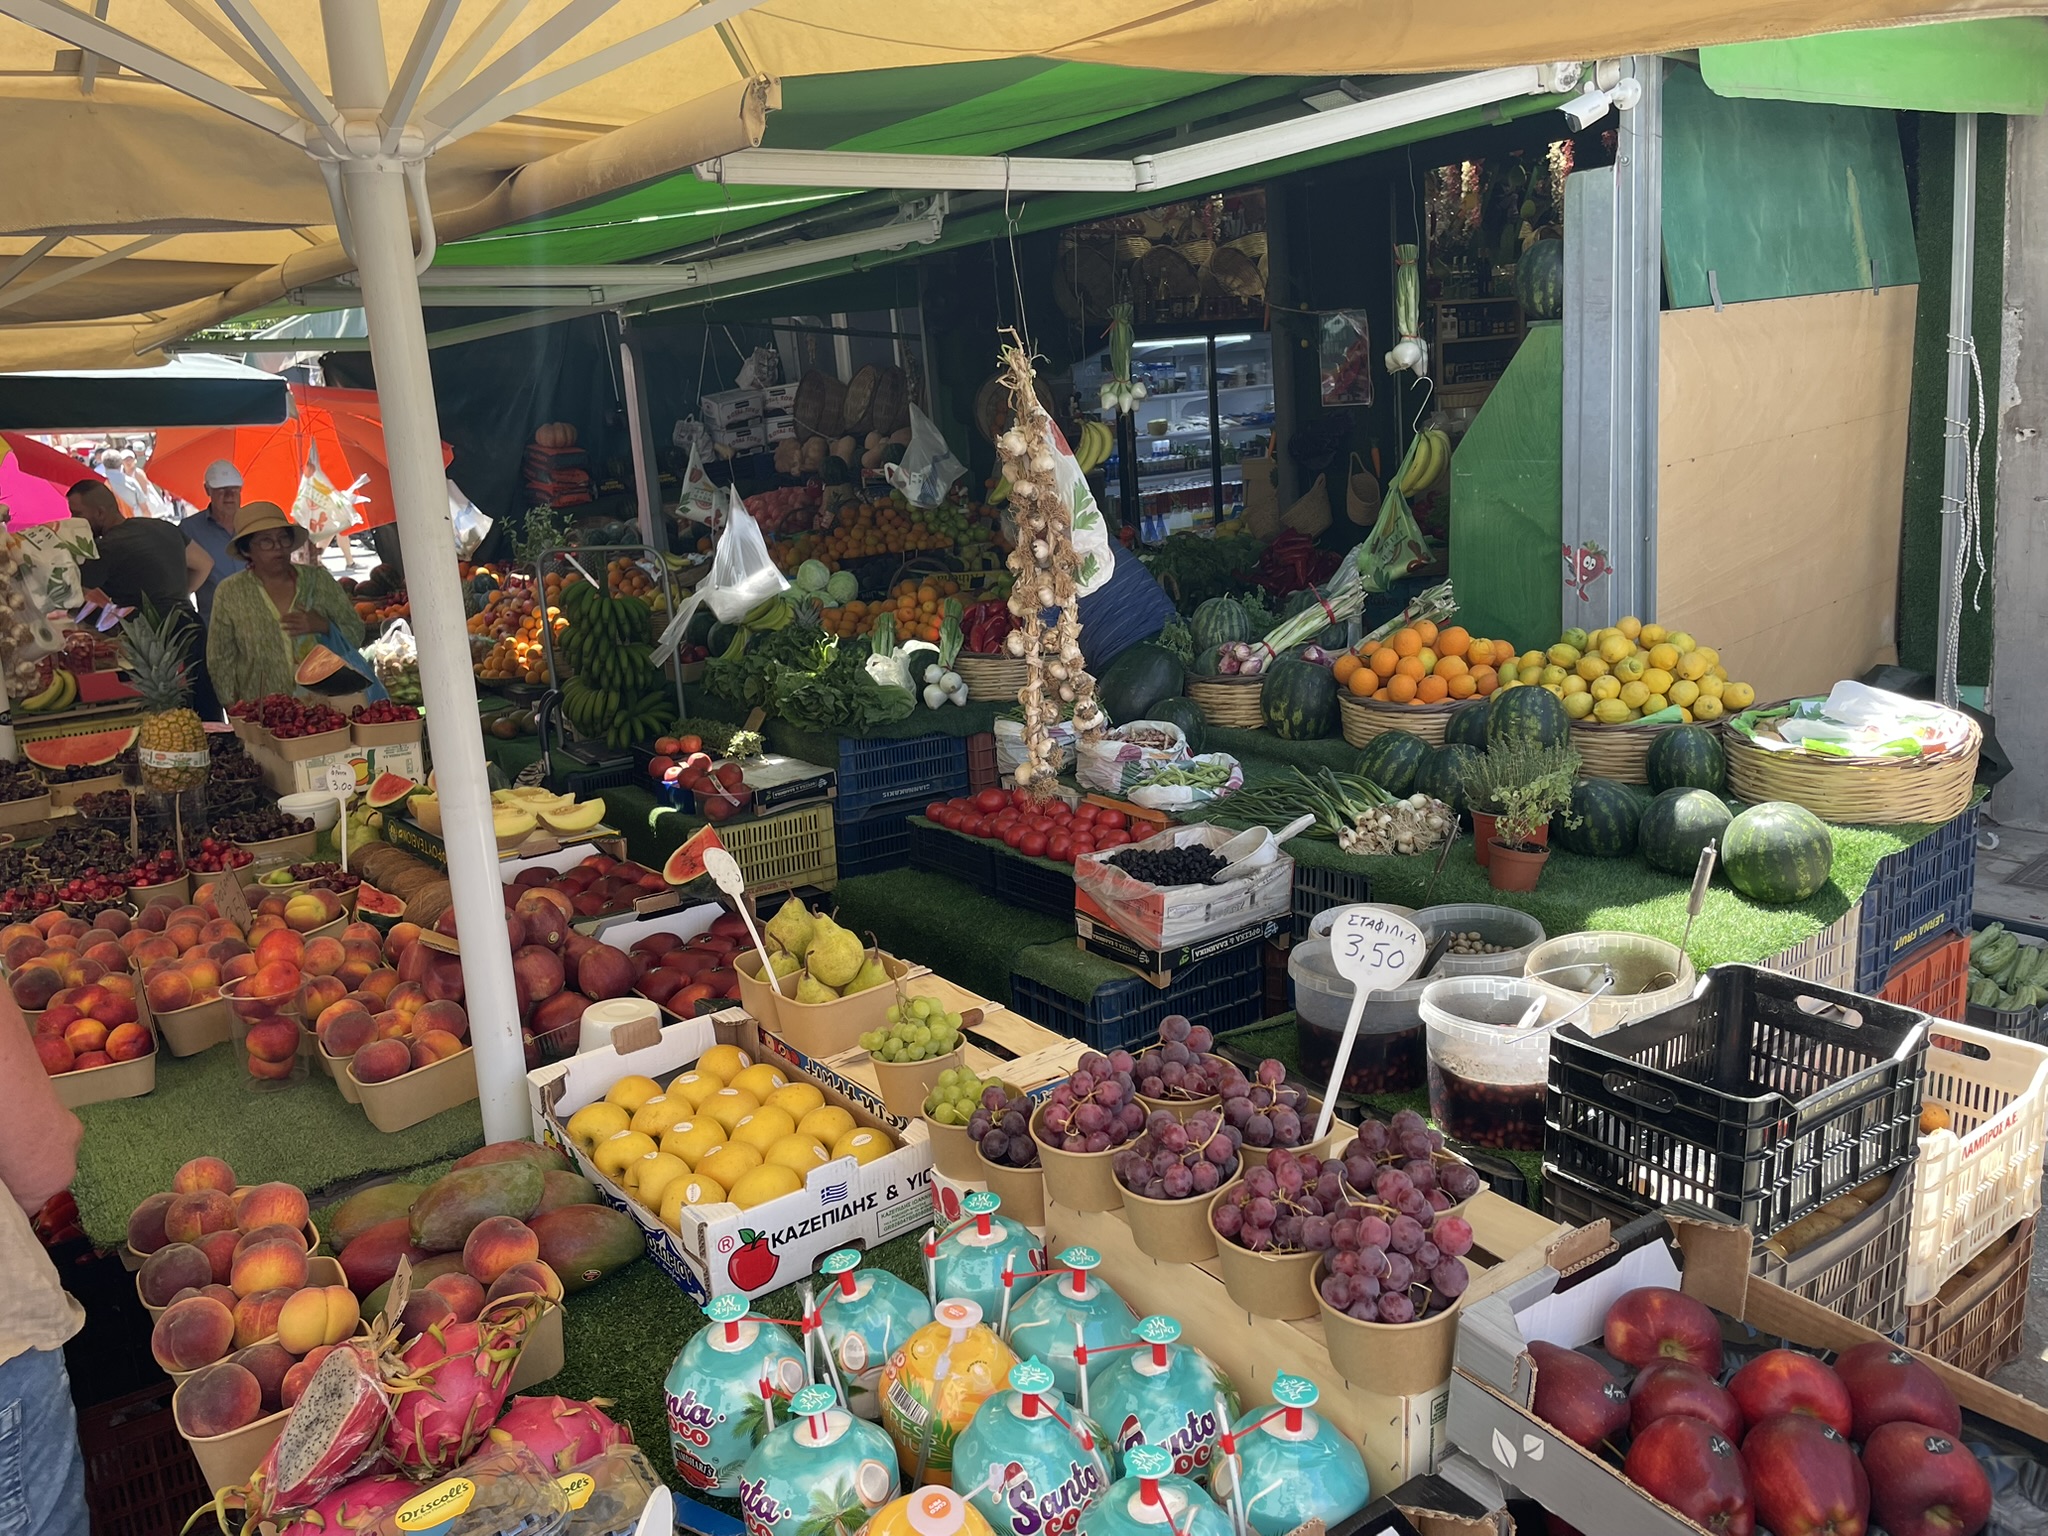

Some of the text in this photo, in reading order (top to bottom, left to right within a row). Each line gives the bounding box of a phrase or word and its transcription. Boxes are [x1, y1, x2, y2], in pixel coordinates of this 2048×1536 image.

[1345, 933, 1405, 969] 3,50
[1893, 913, 1945, 952] LERNA FRUIT
[771, 1191, 879, 1249] ΚΑΖΕΠΙΔΗΣ
[886, 1184, 899, 1201] &
[664, 1388, 716, 1428] nta
[398, 1482, 469, 1523] Driscoll's
[1009, 1461, 1100, 1536] Santa
